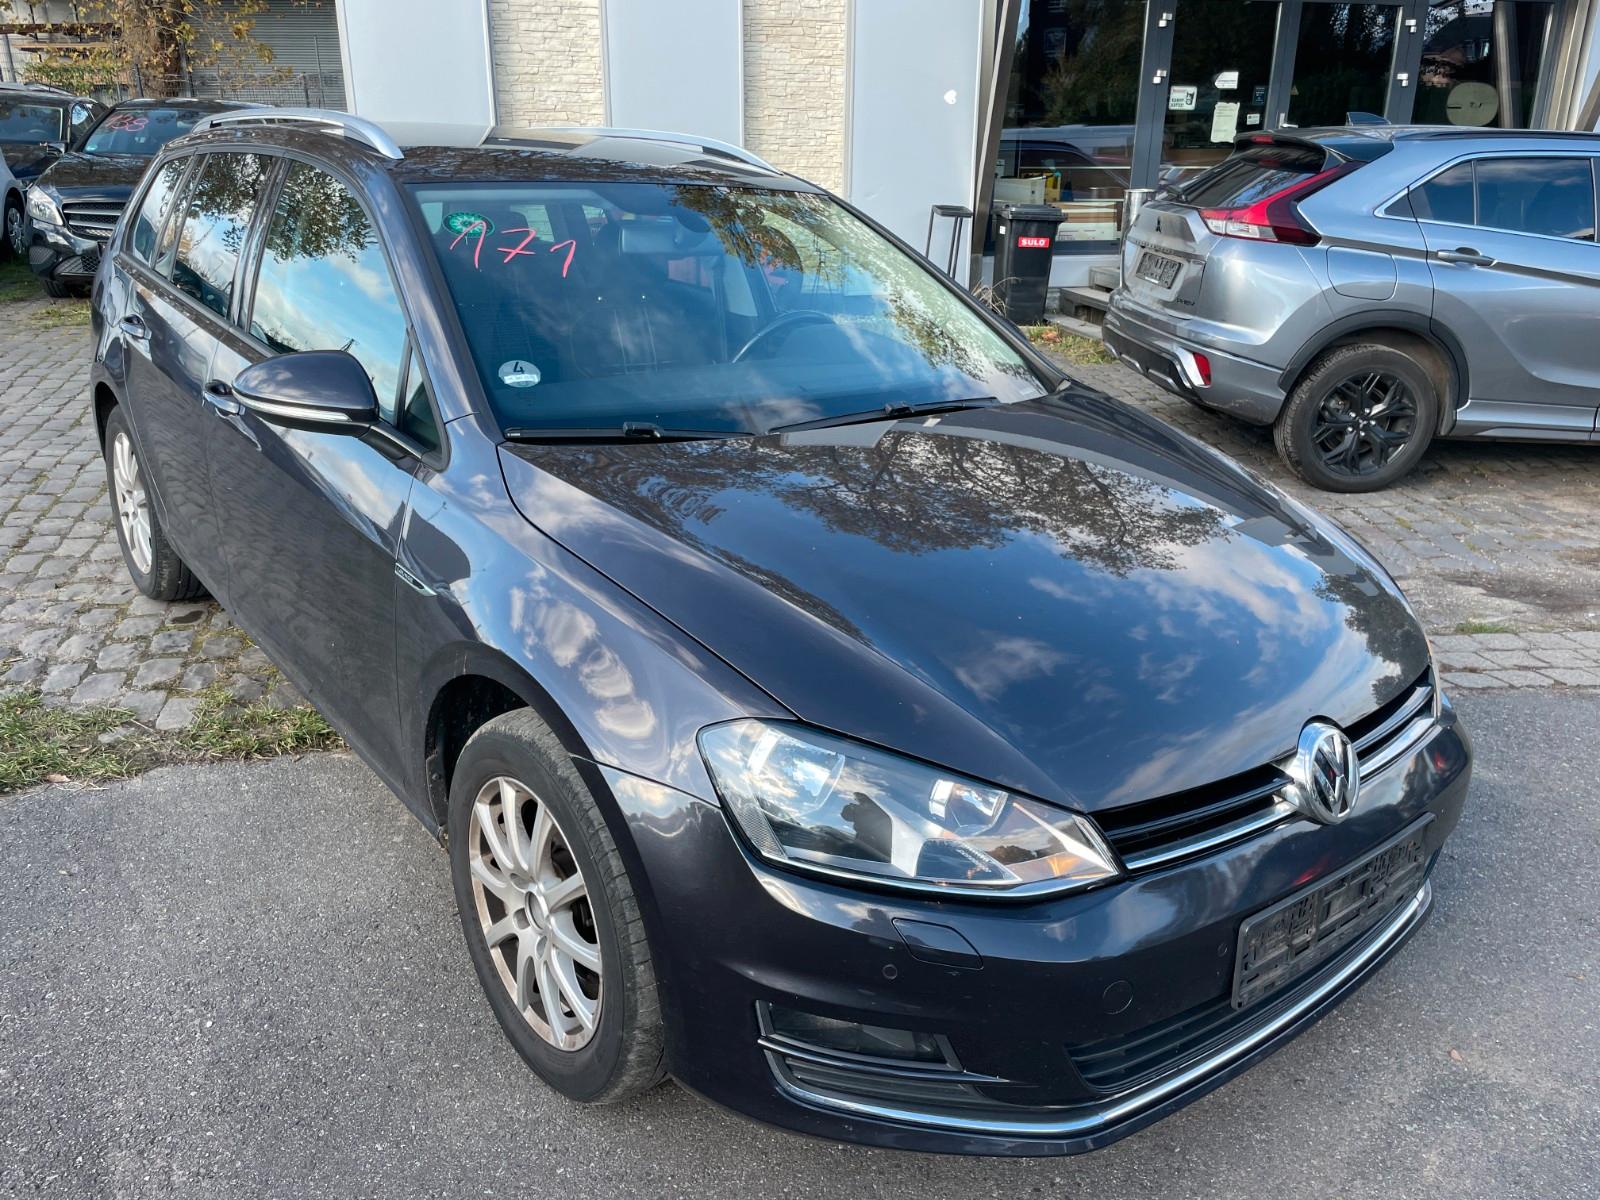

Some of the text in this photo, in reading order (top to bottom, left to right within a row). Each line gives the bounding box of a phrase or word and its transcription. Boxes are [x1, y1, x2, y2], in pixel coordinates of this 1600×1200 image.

[449, 219, 577, 279] 171
[1021, 238, 1046, 246] SULO
[512, 361, 525, 375] 4
